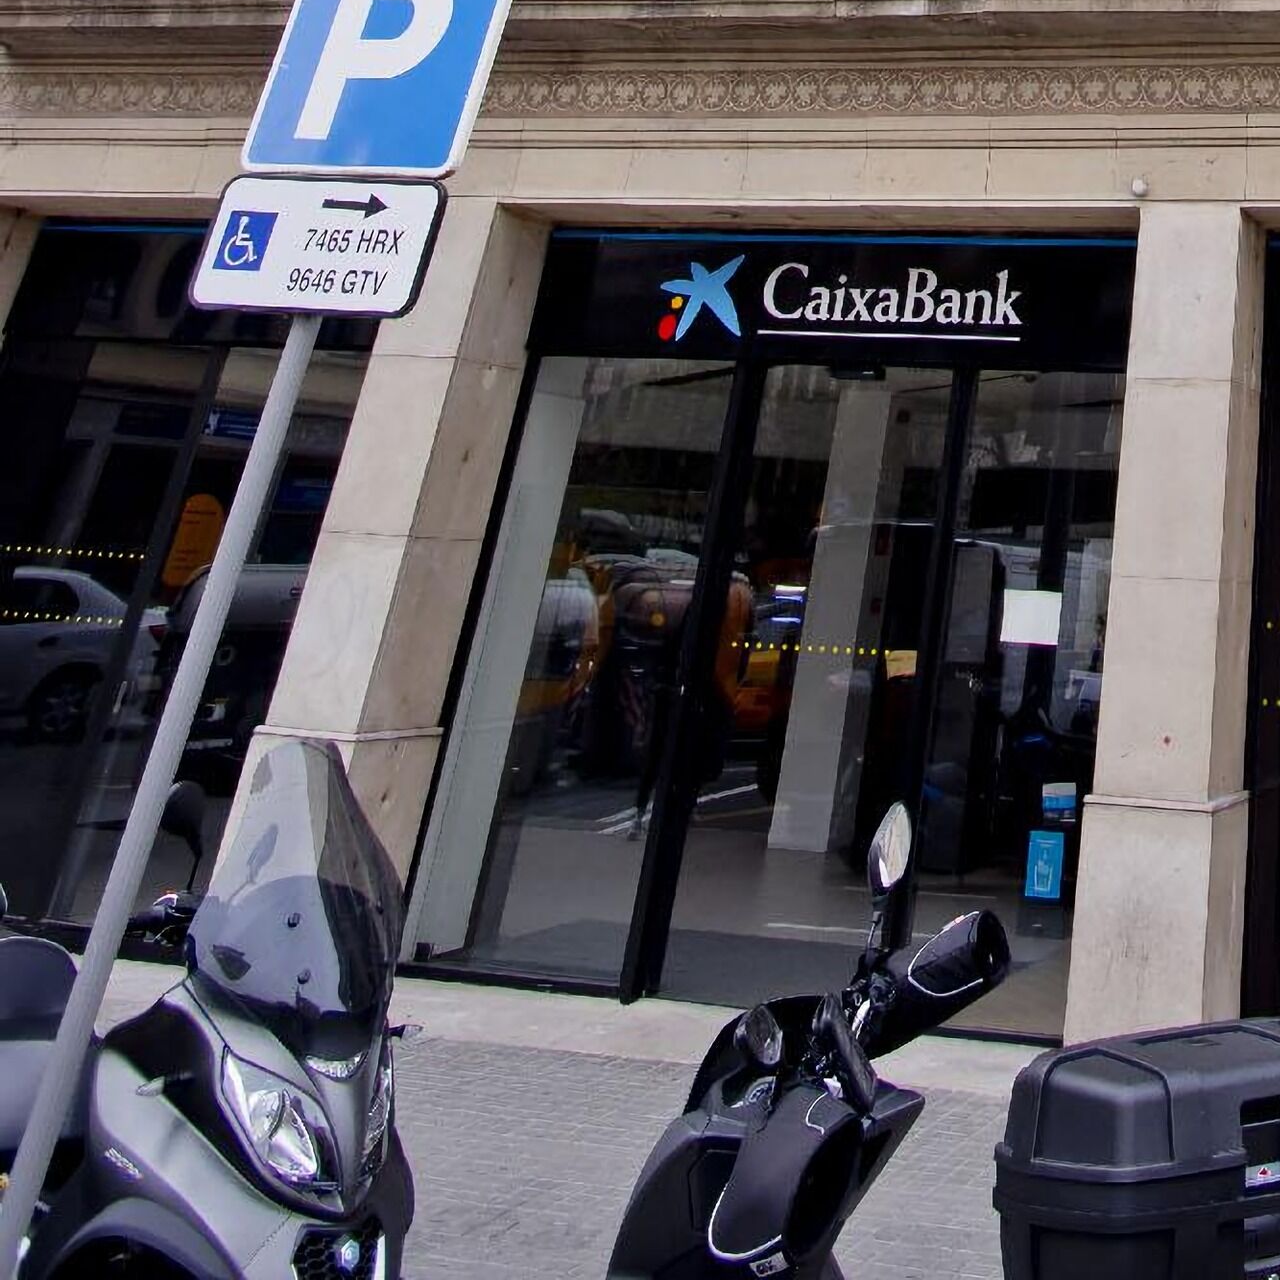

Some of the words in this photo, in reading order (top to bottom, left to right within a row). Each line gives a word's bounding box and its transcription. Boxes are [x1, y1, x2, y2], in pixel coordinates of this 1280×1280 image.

[302, 227, 351, 253] 7465
[355, 228, 405, 255] HRX
[286, 266, 335, 293] 9646
[340, 269, 389, 296] GTV
[762, 262, 1024, 325] CaixaBank
